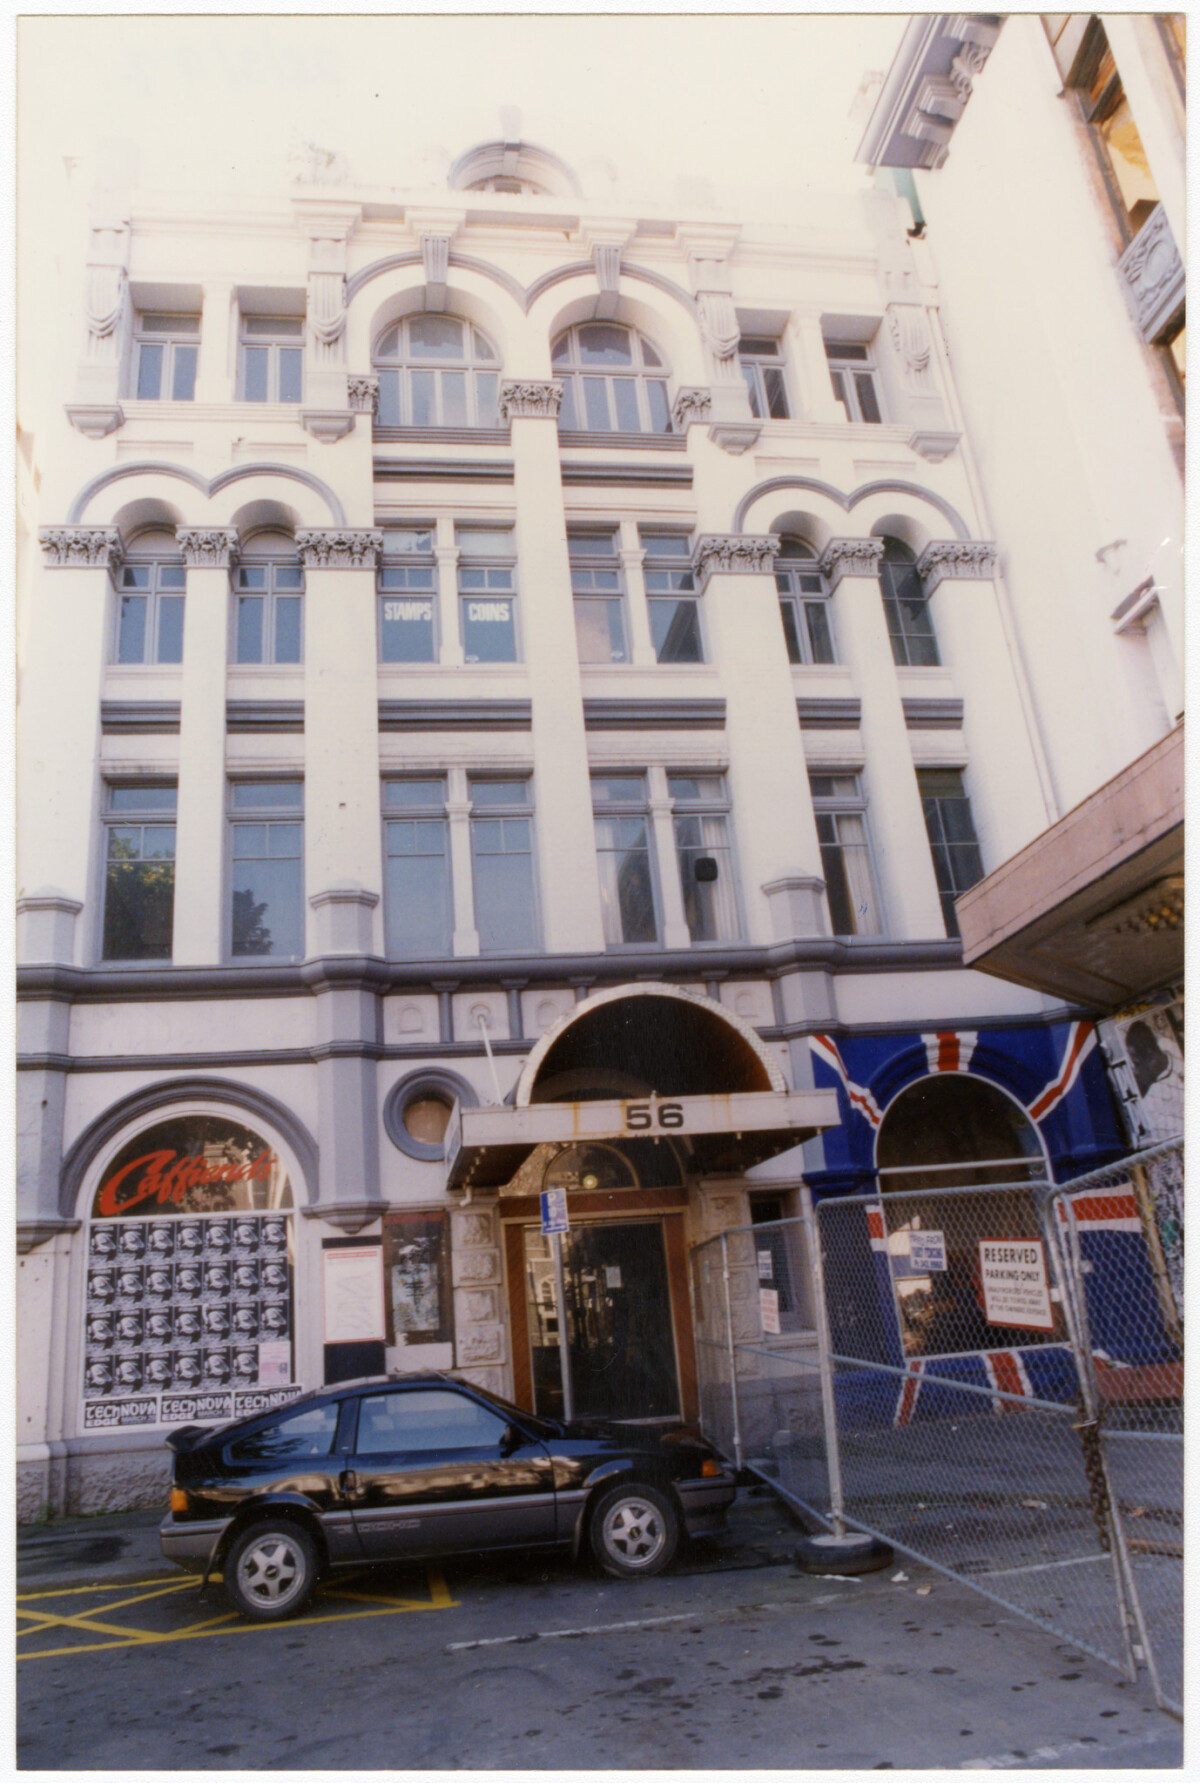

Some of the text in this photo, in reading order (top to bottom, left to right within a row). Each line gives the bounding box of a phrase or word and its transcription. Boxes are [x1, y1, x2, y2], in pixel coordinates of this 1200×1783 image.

[384, 602, 432, 621] STAMPS
[468, 603, 510, 621] COINS
[626, 1103, 684, 1130] 56
[99, 1149, 277, 1216] Caffiends
[984, 1247, 1038, 1264] RESERVED
[985, 1268, 1040, 1282] PARKING ONLY
[85, 1419, 119, 1427] EDGE
[162, 1412, 195, 1421] EDGE
